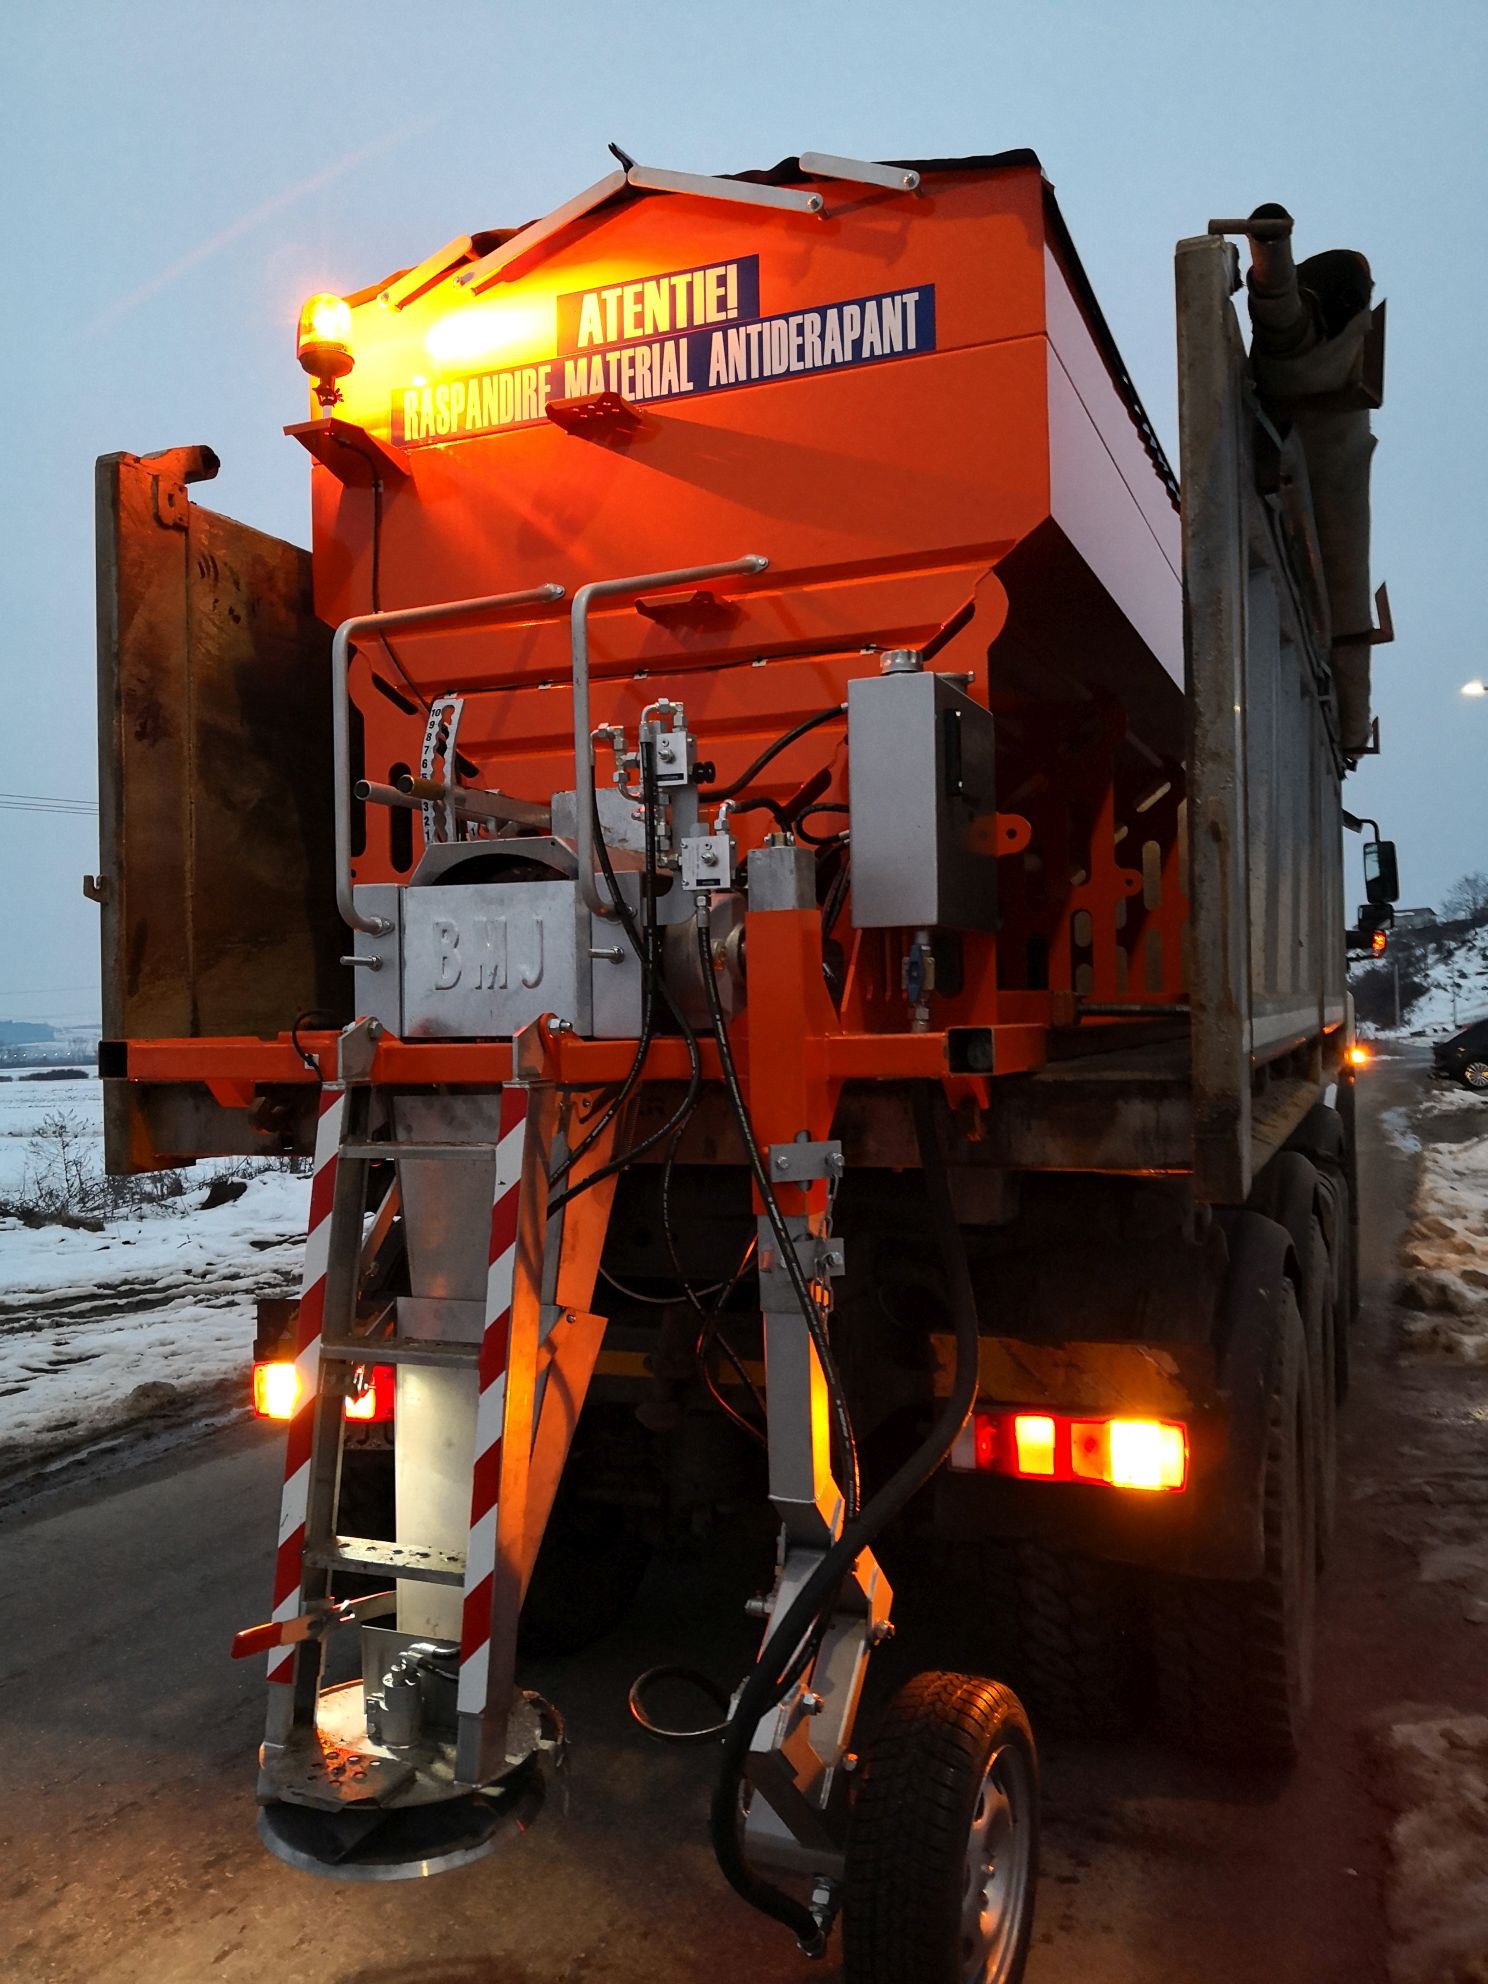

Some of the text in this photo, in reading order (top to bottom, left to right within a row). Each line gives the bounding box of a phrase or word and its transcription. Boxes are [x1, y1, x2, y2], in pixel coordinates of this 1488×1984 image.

[577, 263, 738, 348] ATENTIE!
[403, 291, 919, 441] RASPANDIRE MATERIAL ANTIDERAPANT
[431, 708, 441, 717] 10
[428, 721, 435, 729] 9
[424, 746, 429, 754] 7
[422, 759, 427, 768] 6
[423, 802, 429, 811] 3
[424, 816, 430, 826] 2
[425, 831, 430, 840] 1
[432, 918, 544, 991] BMJ
